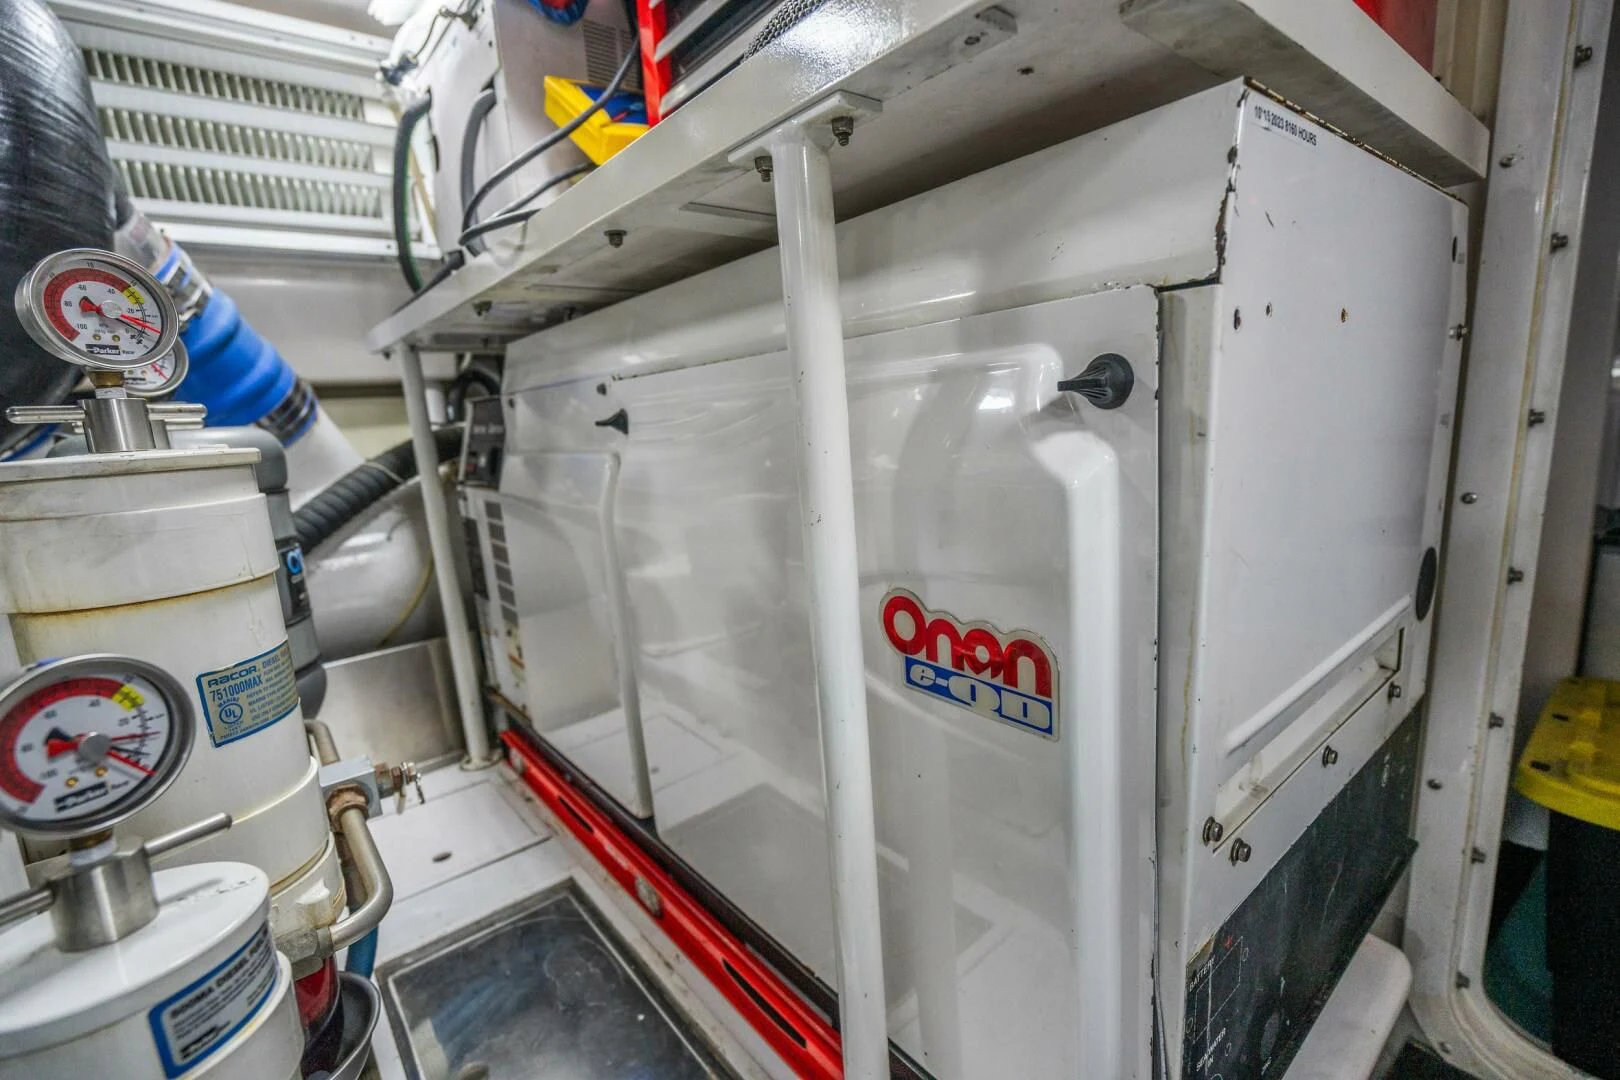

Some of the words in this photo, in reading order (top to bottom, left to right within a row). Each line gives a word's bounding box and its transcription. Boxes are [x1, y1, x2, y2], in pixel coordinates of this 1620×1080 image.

[1298, 127, 1317, 146] HOURS
[210, 674, 263, 703] 751000MAX
[224, 707, 239, 719] UL
